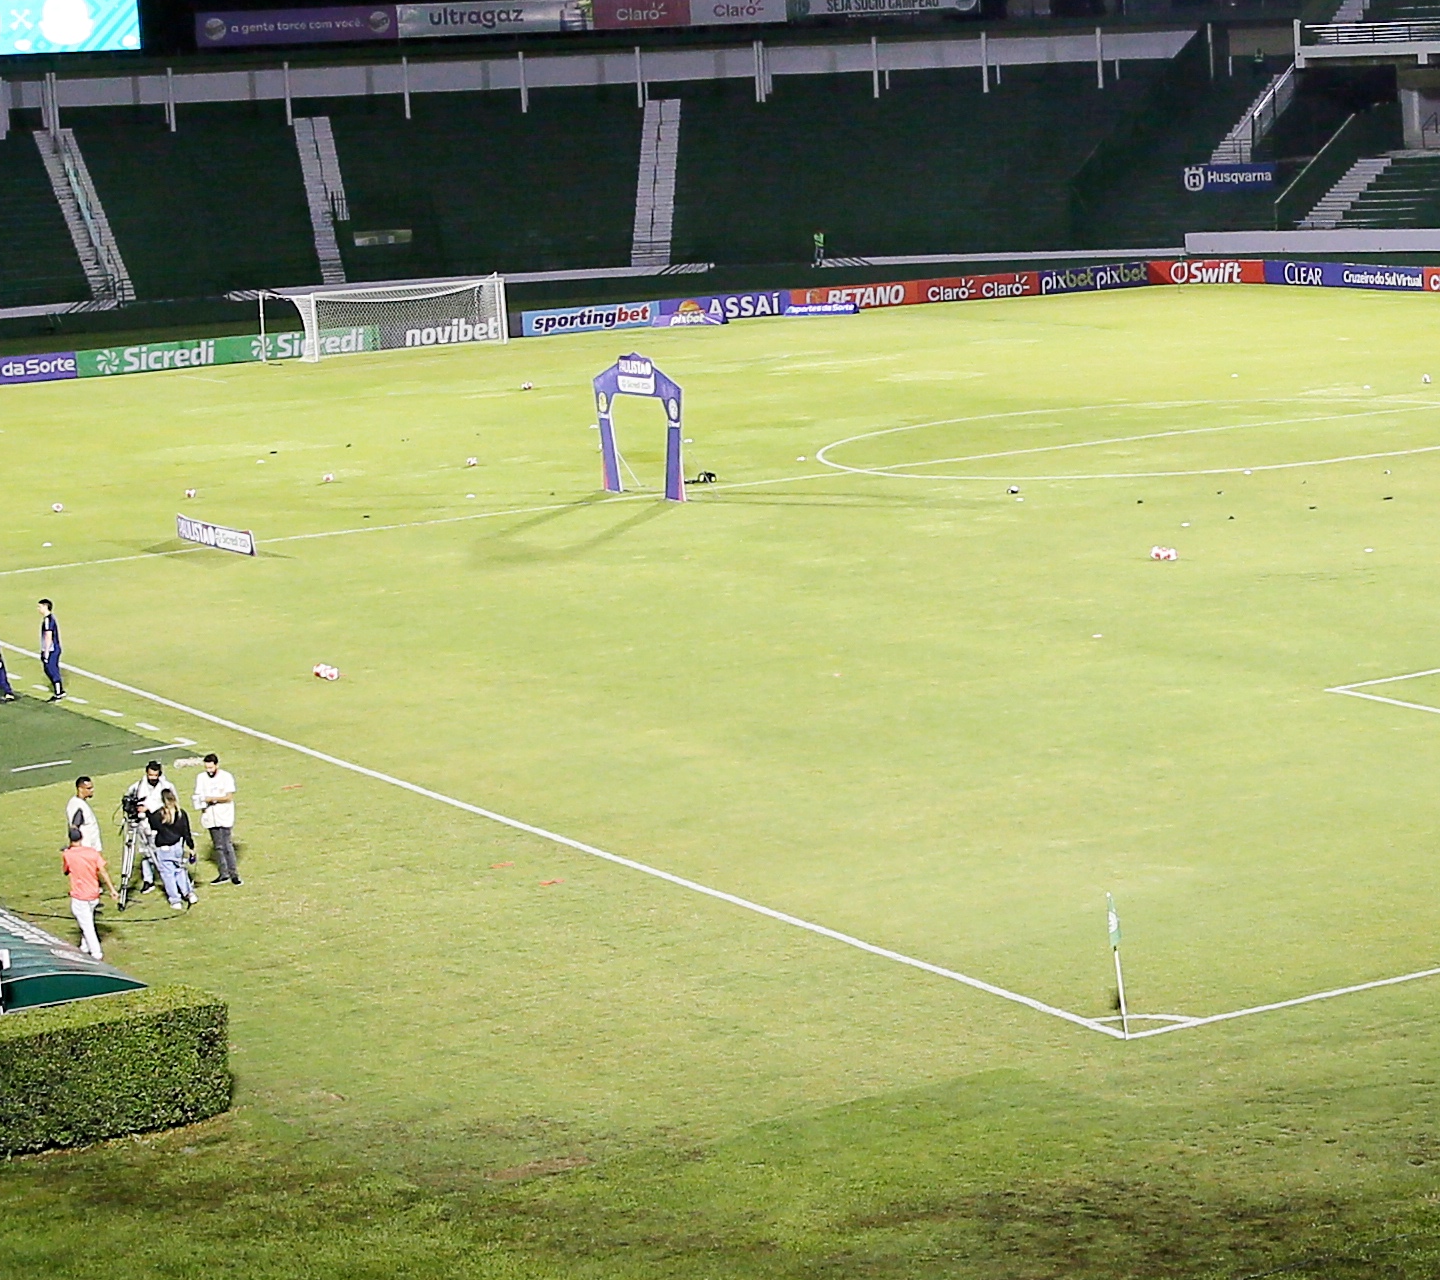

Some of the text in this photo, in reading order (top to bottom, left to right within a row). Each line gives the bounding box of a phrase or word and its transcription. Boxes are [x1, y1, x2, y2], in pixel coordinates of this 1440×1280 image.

[429, 7, 524, 29] ultragaz
[616, 6, 660, 21] Claro
[713, 2, 757, 18] Claro
[231, 25, 239, 33] a
[1207, 171, 1272, 184] Husqvarna
[1041, 268, 1094, 295] pixbet
[1096, 263, 1148, 289] pixbet
[1189, 260, 1242, 284] Swift
[1284, 262, 1323, 286] CLEAR
[1343, 270, 1375, 286] Cruzeiro
[828, 284, 905, 305] BETANO
[928, 285, 968, 302] Claro
[982, 280, 1023, 298] Claro
[534, 306, 649, 333] sportingbet
[405, 319, 499, 347] novibet
[123, 340, 215, 372] Sicredi
